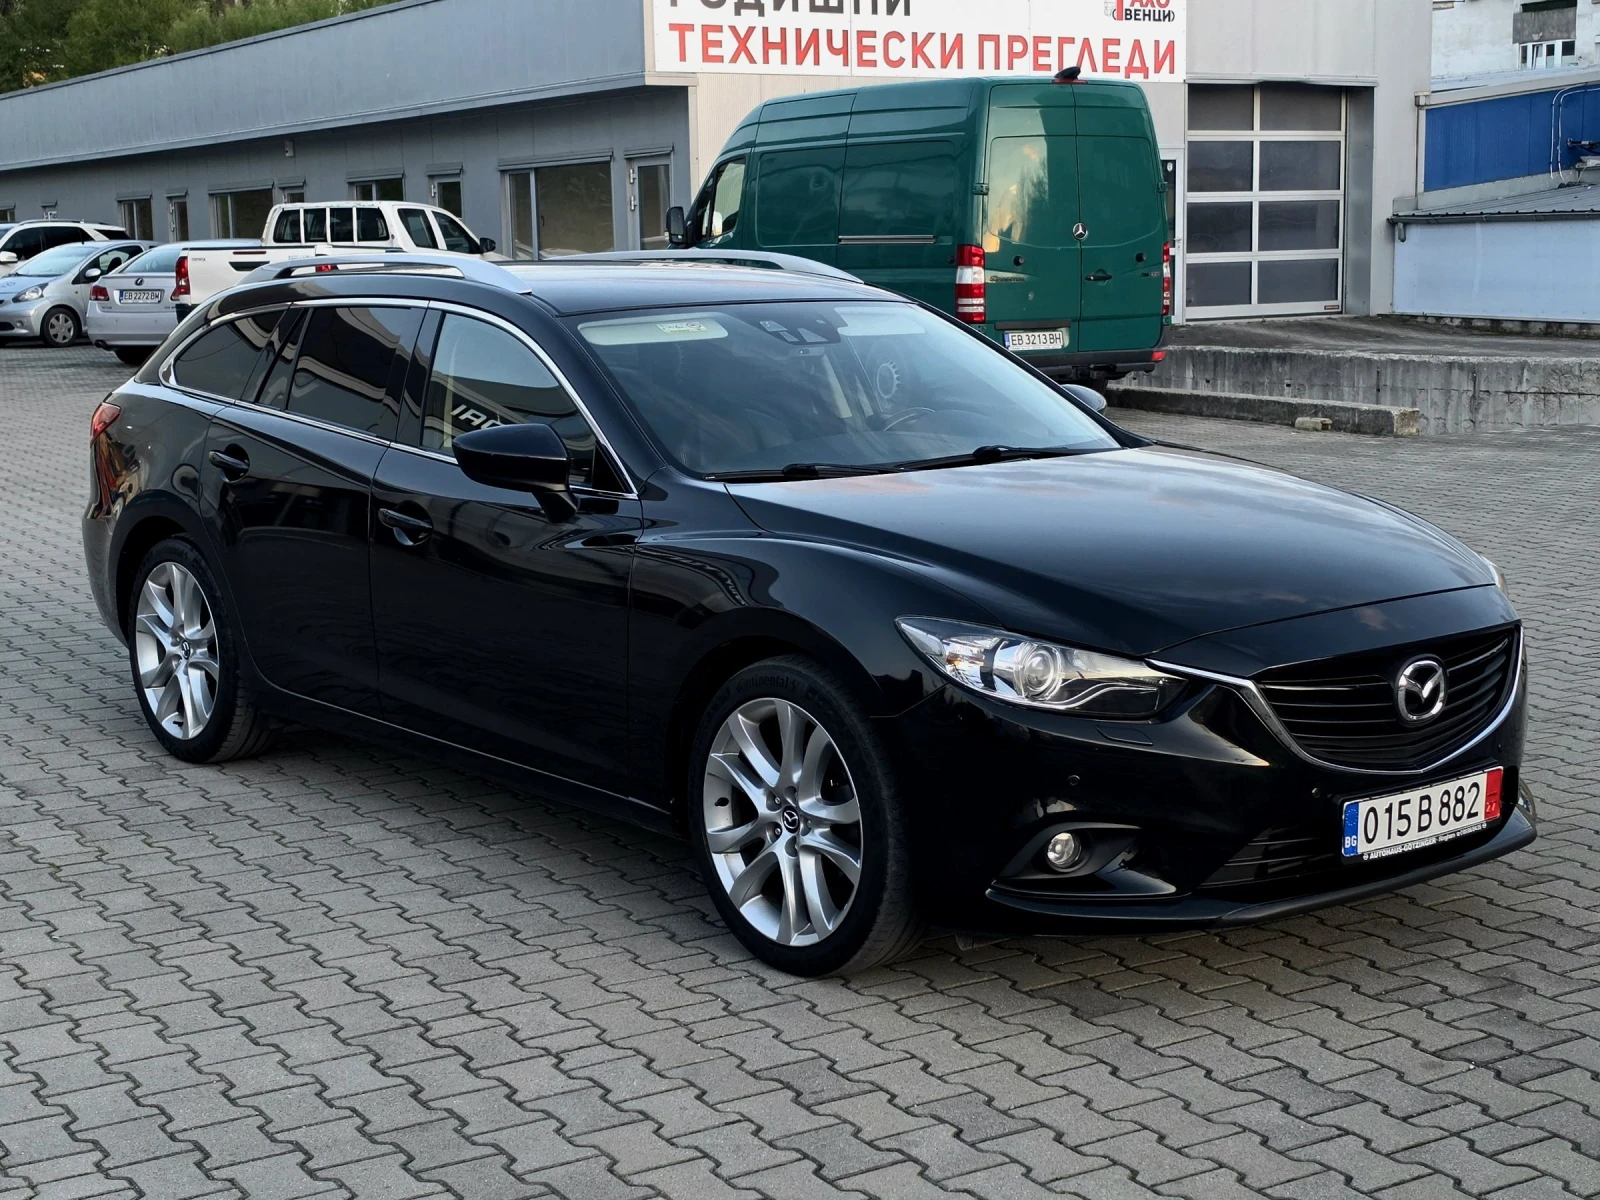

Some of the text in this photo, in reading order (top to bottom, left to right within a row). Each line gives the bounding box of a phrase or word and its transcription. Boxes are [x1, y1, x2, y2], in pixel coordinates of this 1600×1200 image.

[668, 23, 1175, 80] ТЕХНИЧЕСКИ ПРЕГЛЕДИ
[1010, 332, 1062, 346] EB 3213 BH
[1344, 836, 1357, 849] BG
